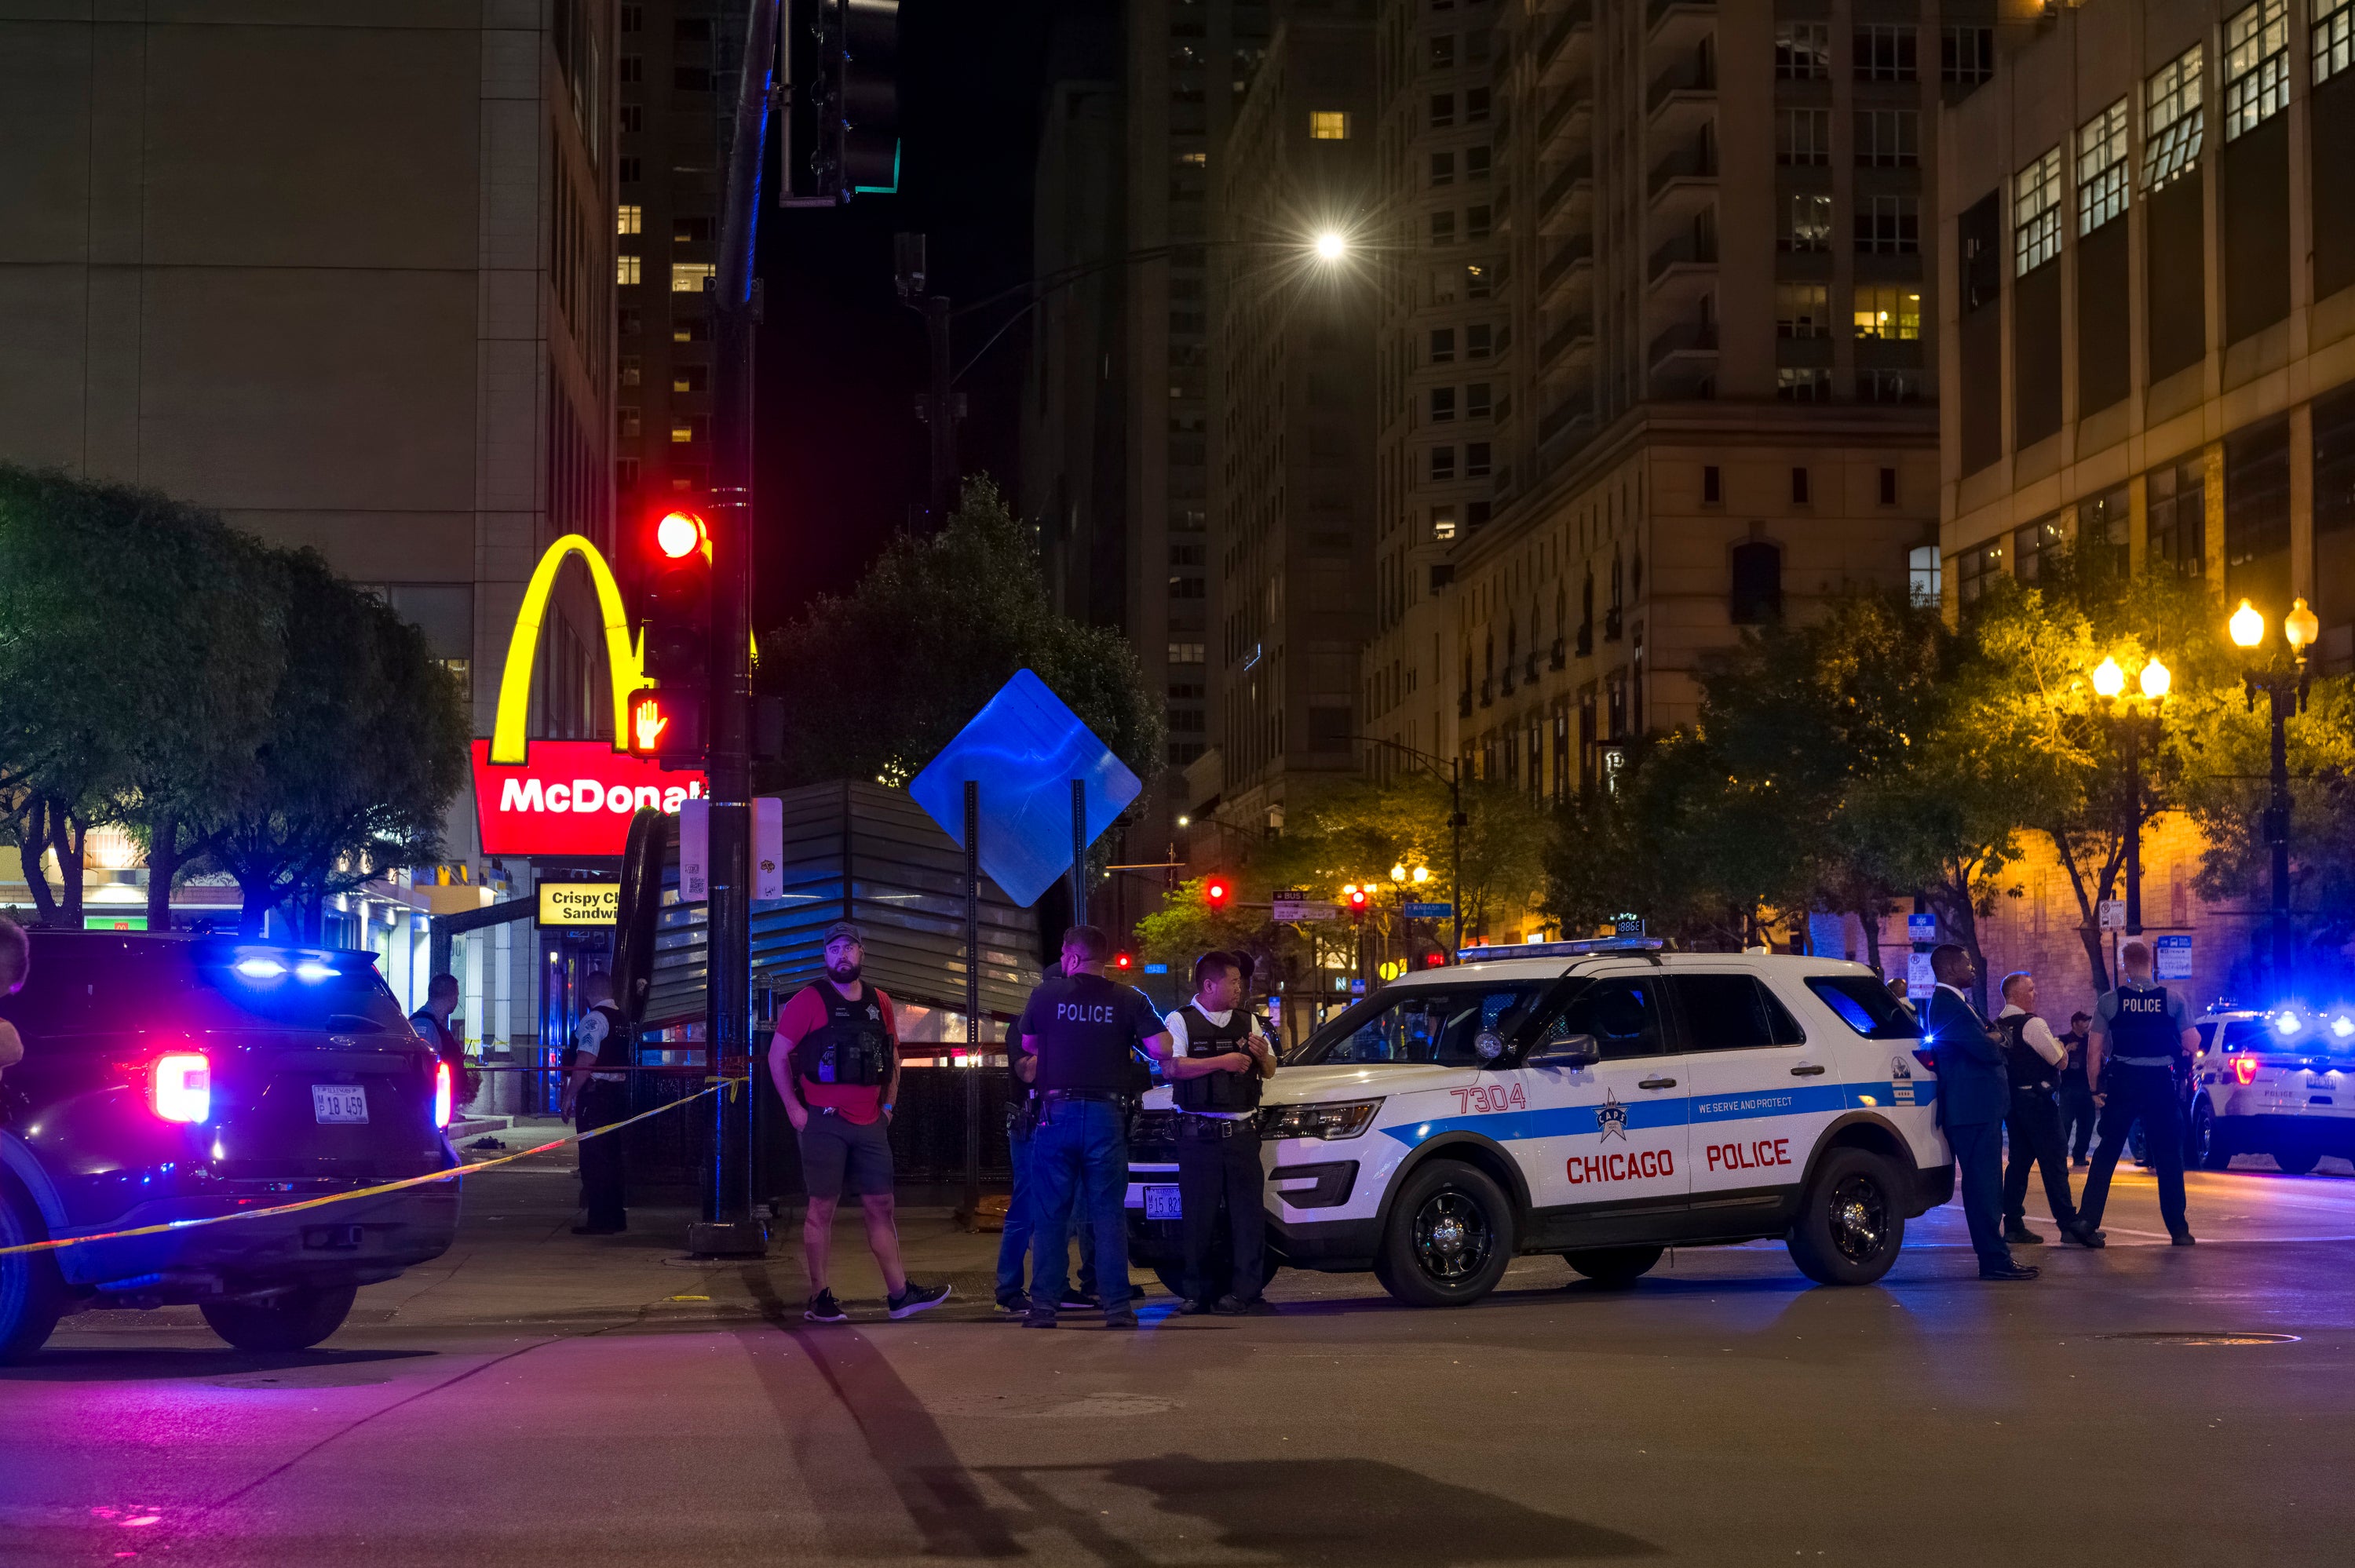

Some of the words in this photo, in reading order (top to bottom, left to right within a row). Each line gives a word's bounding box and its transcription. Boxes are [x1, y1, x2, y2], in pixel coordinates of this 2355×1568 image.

[500, 779, 710, 813] McDonal
[553, 891, 600, 906] Crispy
[1057, 1003, 1114, 1023] POLICE
[2123, 998, 2161, 1012] POLICE
[1450, 1083, 1526, 1114] 7304
[1699, 1103, 1711, 1114] WE
[1712, 1101, 1739, 1112] SERVE
[1740, 1099, 1755, 1110] AND
[1757, 1096, 1792, 1108] PROTECT
[1598, 1111, 1625, 1123] CAPS
[1566, 1150, 1674, 1183] CHICAGO
[1707, 1138, 1791, 1172] POLICE
